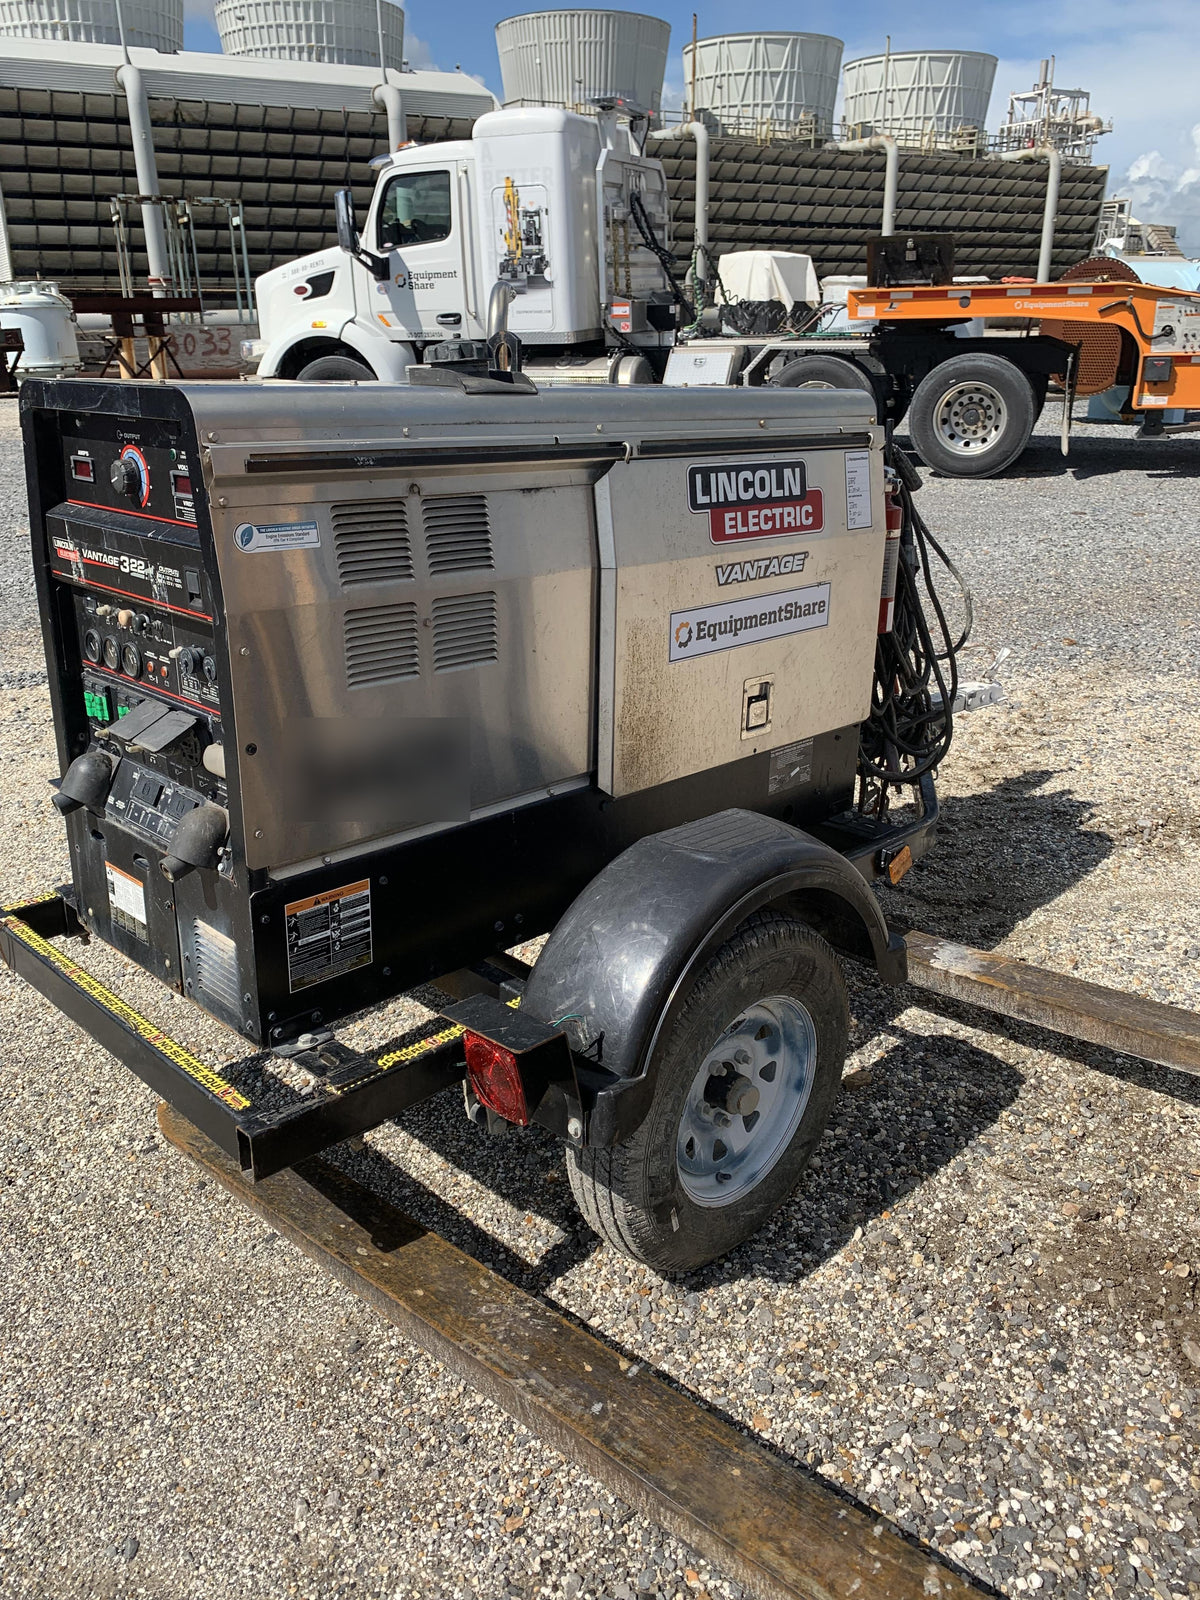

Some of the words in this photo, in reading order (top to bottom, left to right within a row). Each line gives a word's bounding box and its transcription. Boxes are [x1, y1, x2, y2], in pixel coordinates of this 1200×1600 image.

[407, 270, 457, 281] Equipment
[408, 281, 435, 290] Share
[1023, 301, 1090, 309] EquipmentShare
[695, 467, 802, 505] LINCOLN
[724, 504, 814, 535] ELECTRIC
[54, 539, 75, 551] LINCOLN
[81, 548, 119, 567] VANTAGE
[119, 555, 146, 574] 322
[716, 553, 806, 585] VANTAGE
[695, 600, 827, 642] EquipmentShare
[160, 1040, 174, 1051] NO
[170, 1050, 184, 1060] SE
[181, 1058, 205, 1076] PARE
[201, 1073, 223, 1090] AQUI
